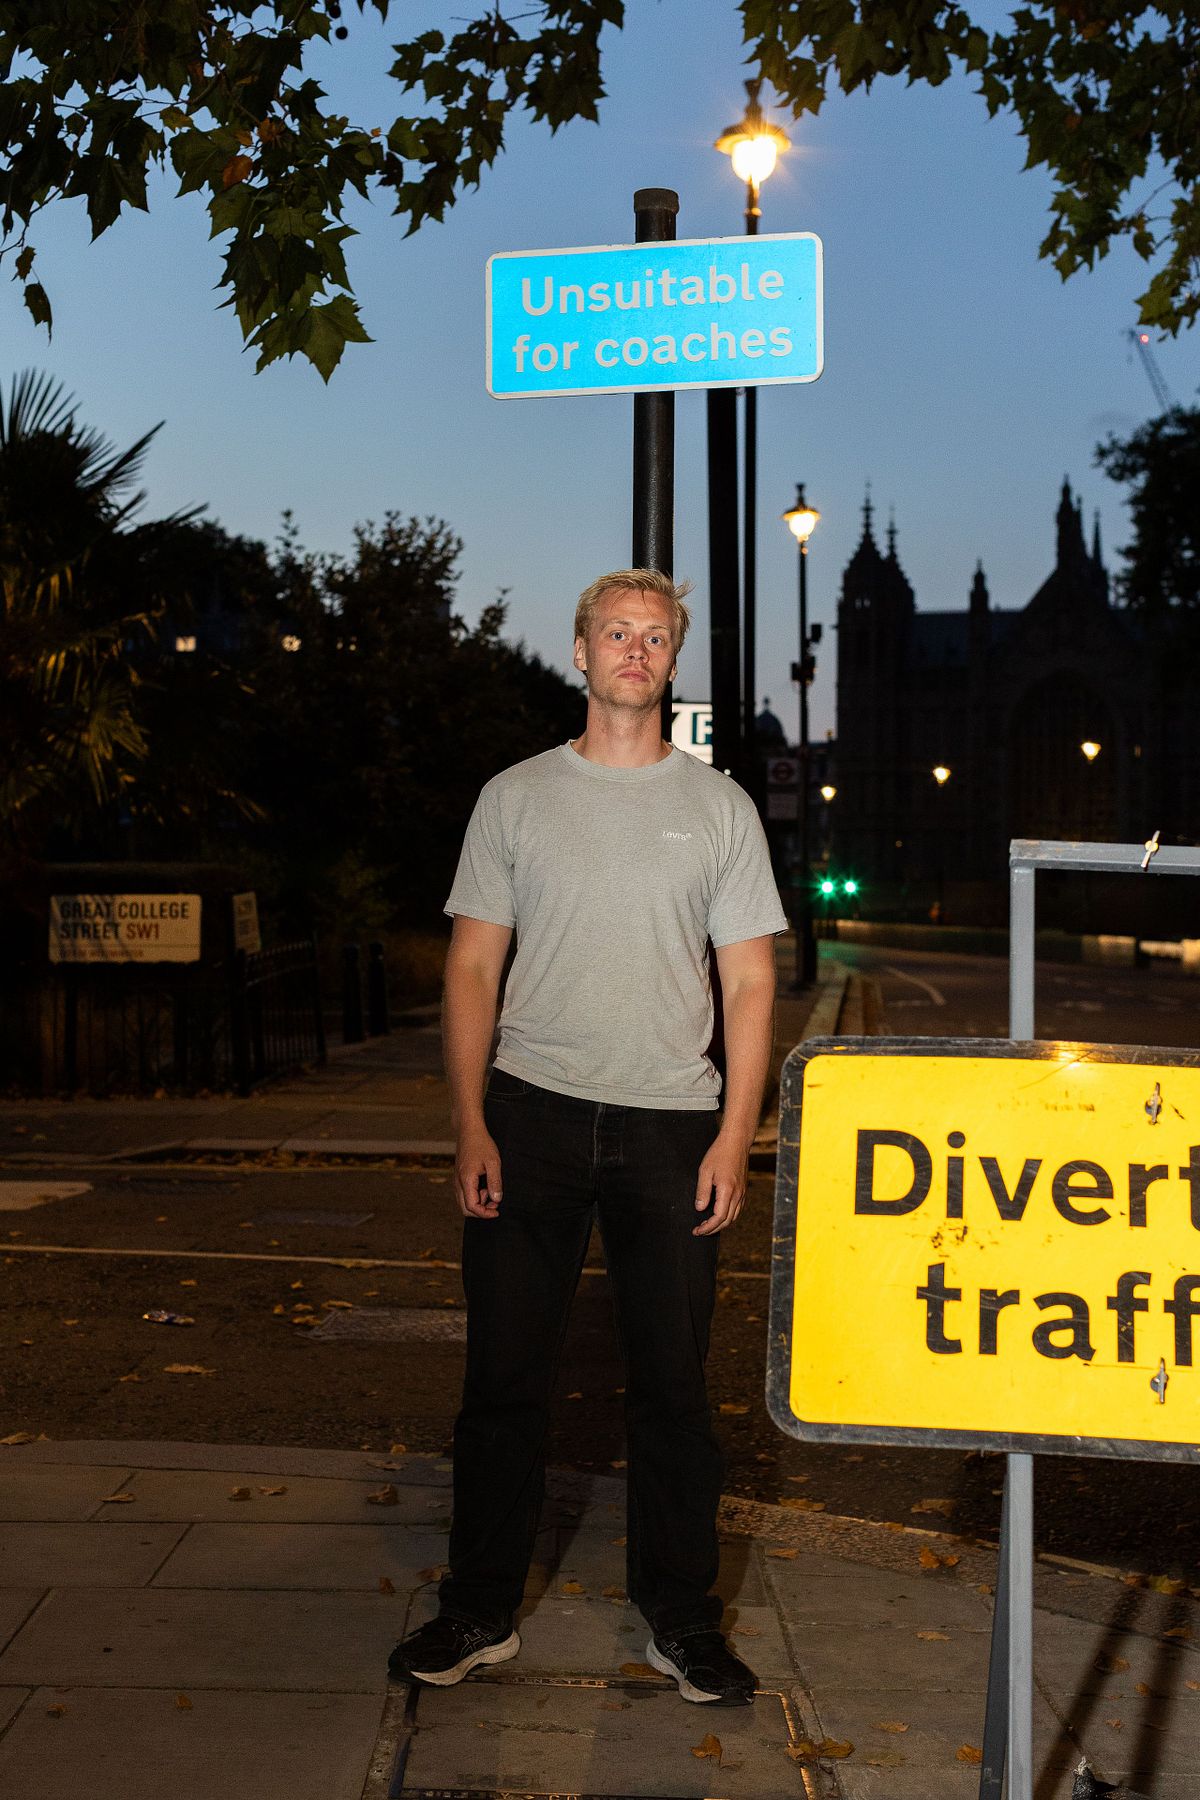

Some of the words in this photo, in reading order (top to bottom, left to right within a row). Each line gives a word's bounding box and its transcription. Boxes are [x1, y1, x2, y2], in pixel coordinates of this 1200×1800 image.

[521, 263, 785, 316] Unsuitable
[512, 334, 579, 373] for
[594, 322, 793, 368] coaches
[60, 901, 111, 919] GREAT
[118, 901, 190, 919] COLLEGE
[60, 922, 120, 939] STREET
[126, 923, 159, 939] SW1
[916, 1262, 1200, 1367] traff
